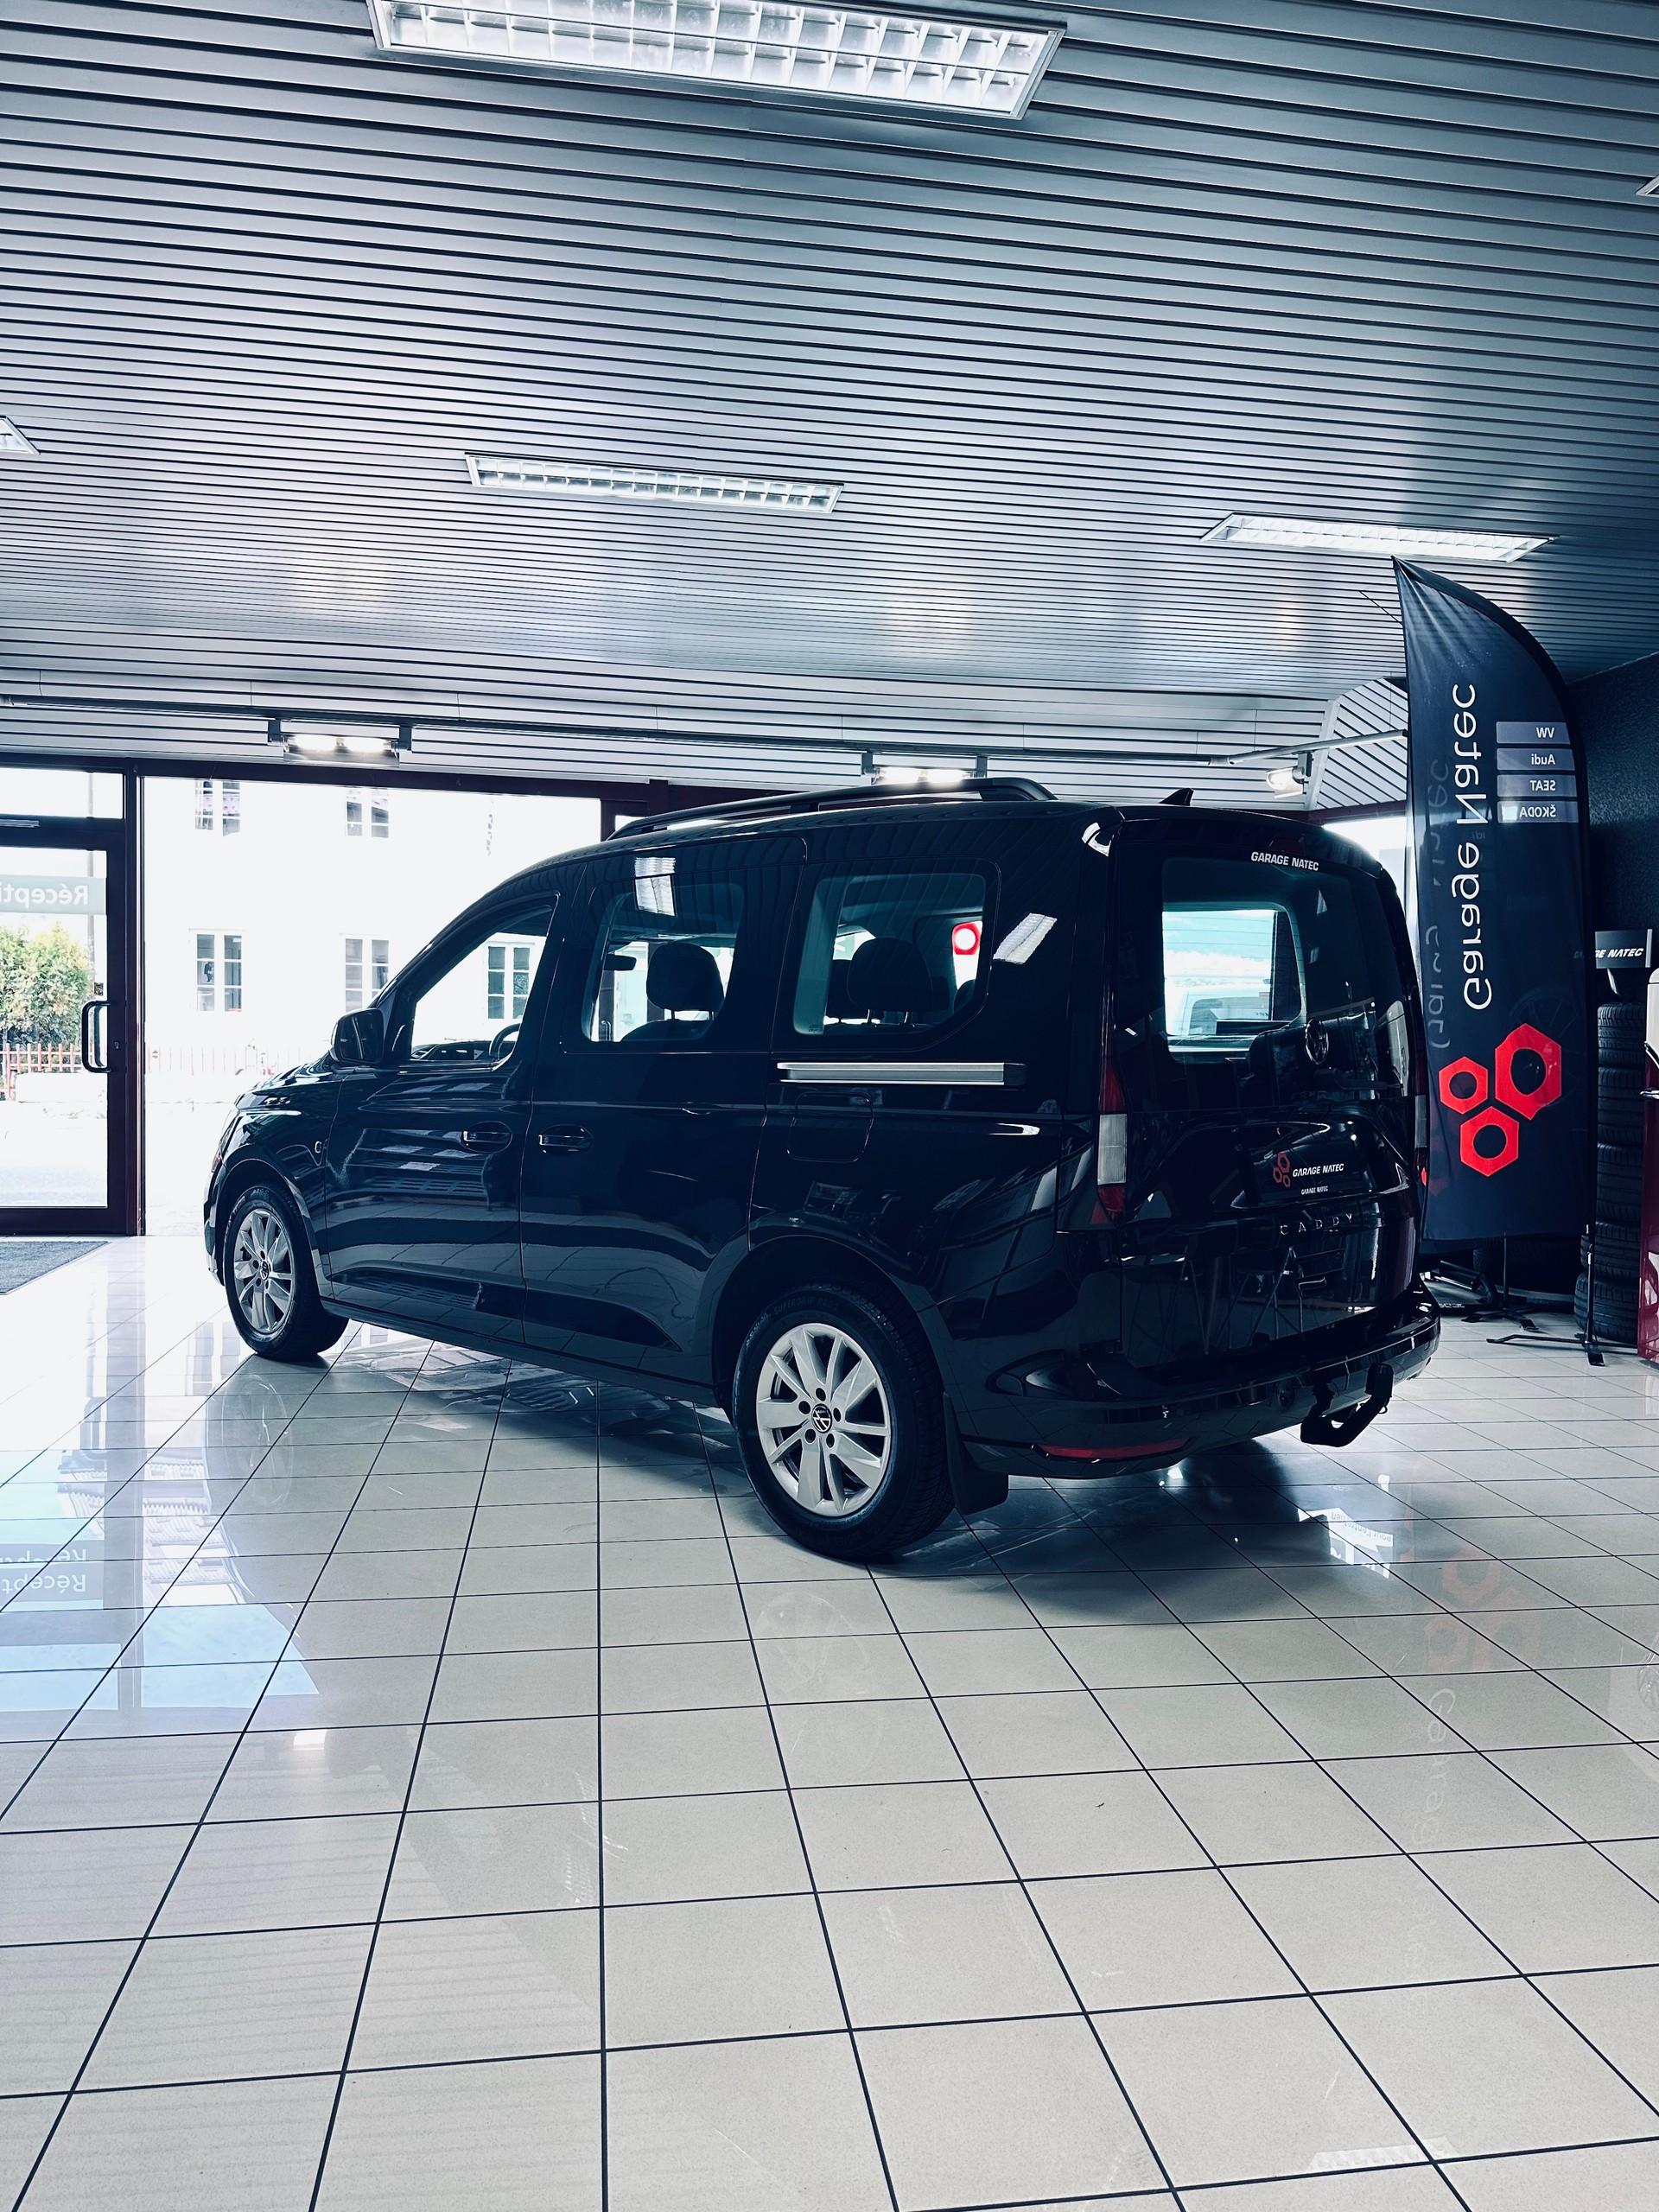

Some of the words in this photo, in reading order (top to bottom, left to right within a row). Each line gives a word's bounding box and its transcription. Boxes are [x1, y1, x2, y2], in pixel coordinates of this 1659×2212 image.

[1250, 851, 1289, 866] GARAGE
[1291, 856, 1319, 872] NATEC
[1606, 947, 1644, 958] NATEC
[1292, 1166, 1321, 1178] GARAGE
[1322, 1162, 1344, 1173] NATEC
[1300, 1186, 1316, 1196] GARAGE
[1280, 1212, 1353, 1236] CADDY
